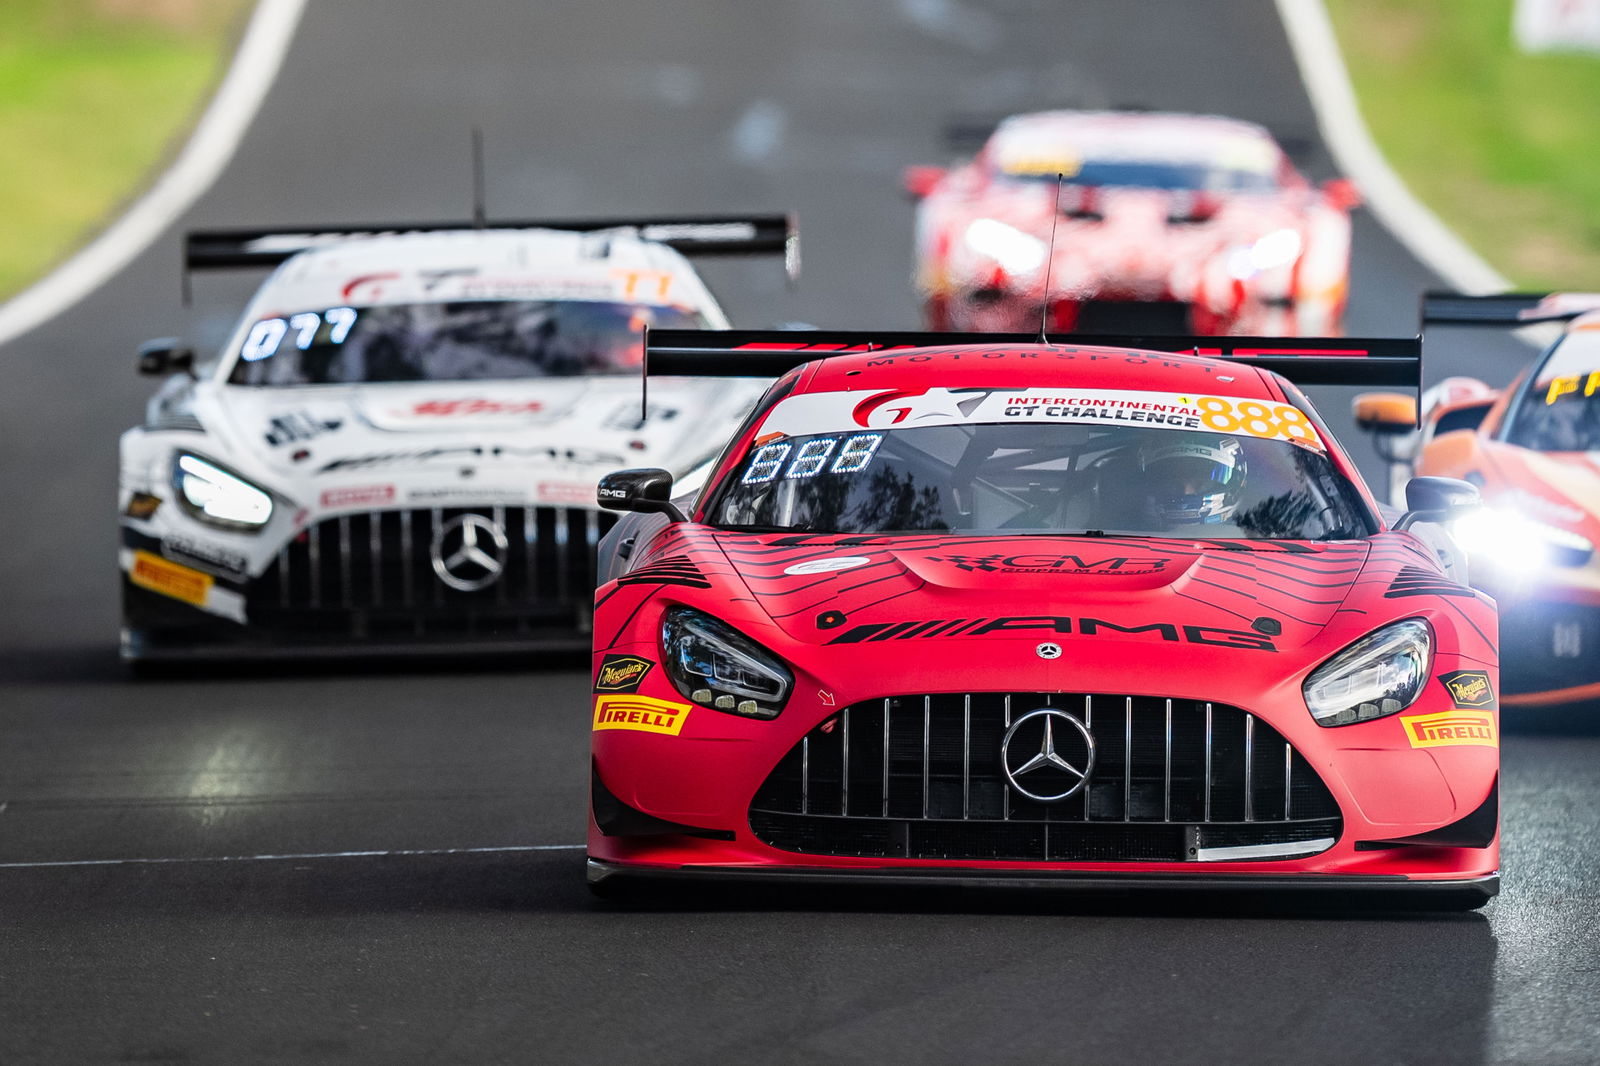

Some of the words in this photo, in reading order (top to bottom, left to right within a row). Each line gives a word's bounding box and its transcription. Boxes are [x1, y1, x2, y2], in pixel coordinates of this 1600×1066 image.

[241, 307, 358, 362] 077
[866, 352, 1215, 373] MOTORSPORT
[1004, 406, 1035, 418] GT
[1046, 406, 1200, 428] CHALLENGE
[1007, 396, 1202, 417] INTERCONTINENTAL
[1197, 396, 1318, 440] 888
[741, 434, 883, 484] 888
[599, 488, 627, 499] AMG
[966, 615, 1280, 653] AMG
[597, 701, 680, 728] PIRELLI
[1411, 717, 1492, 742] PIRELLI
